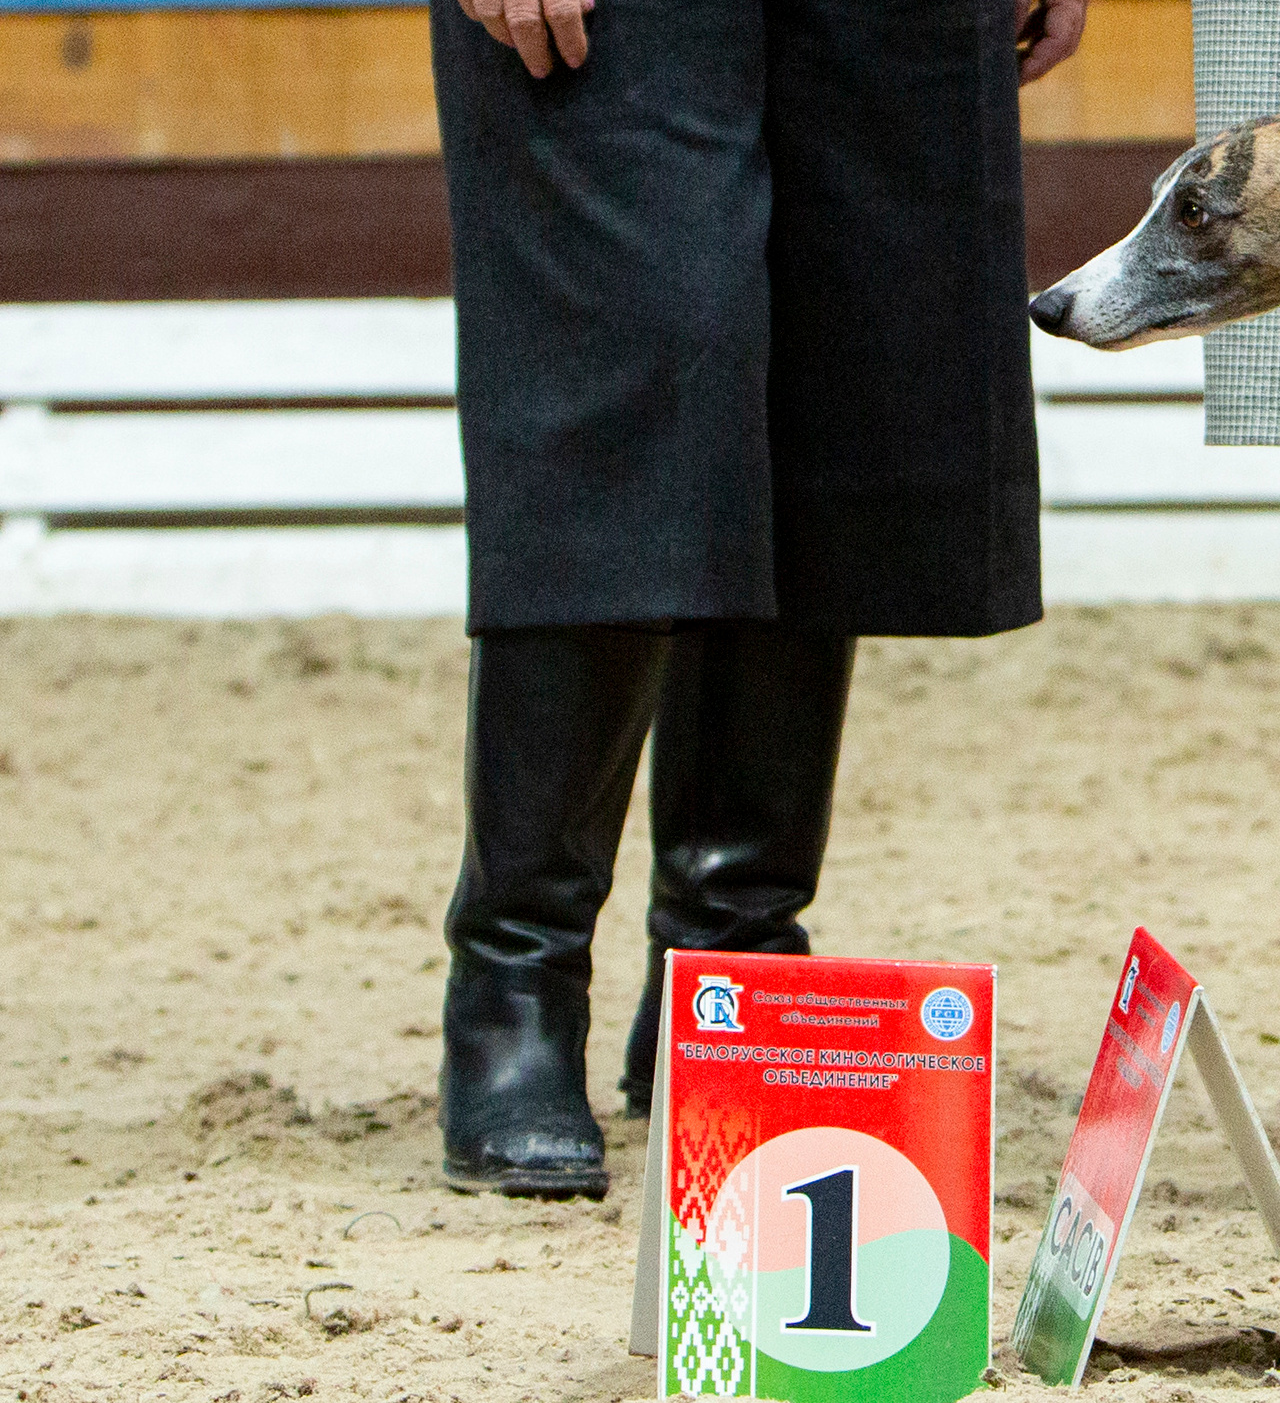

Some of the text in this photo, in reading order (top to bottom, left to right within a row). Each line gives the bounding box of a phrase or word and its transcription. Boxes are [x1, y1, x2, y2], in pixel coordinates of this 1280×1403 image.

[752, 990, 908, 1009] Союз общественных
[780, 1012, 879, 1027] объединений
[819, 1050, 984, 1071] КИНОЛОГИЧЕСКОЕ
[783, 1167, 874, 1334] 1
[1050, 1195, 1105, 1297] CACIB
